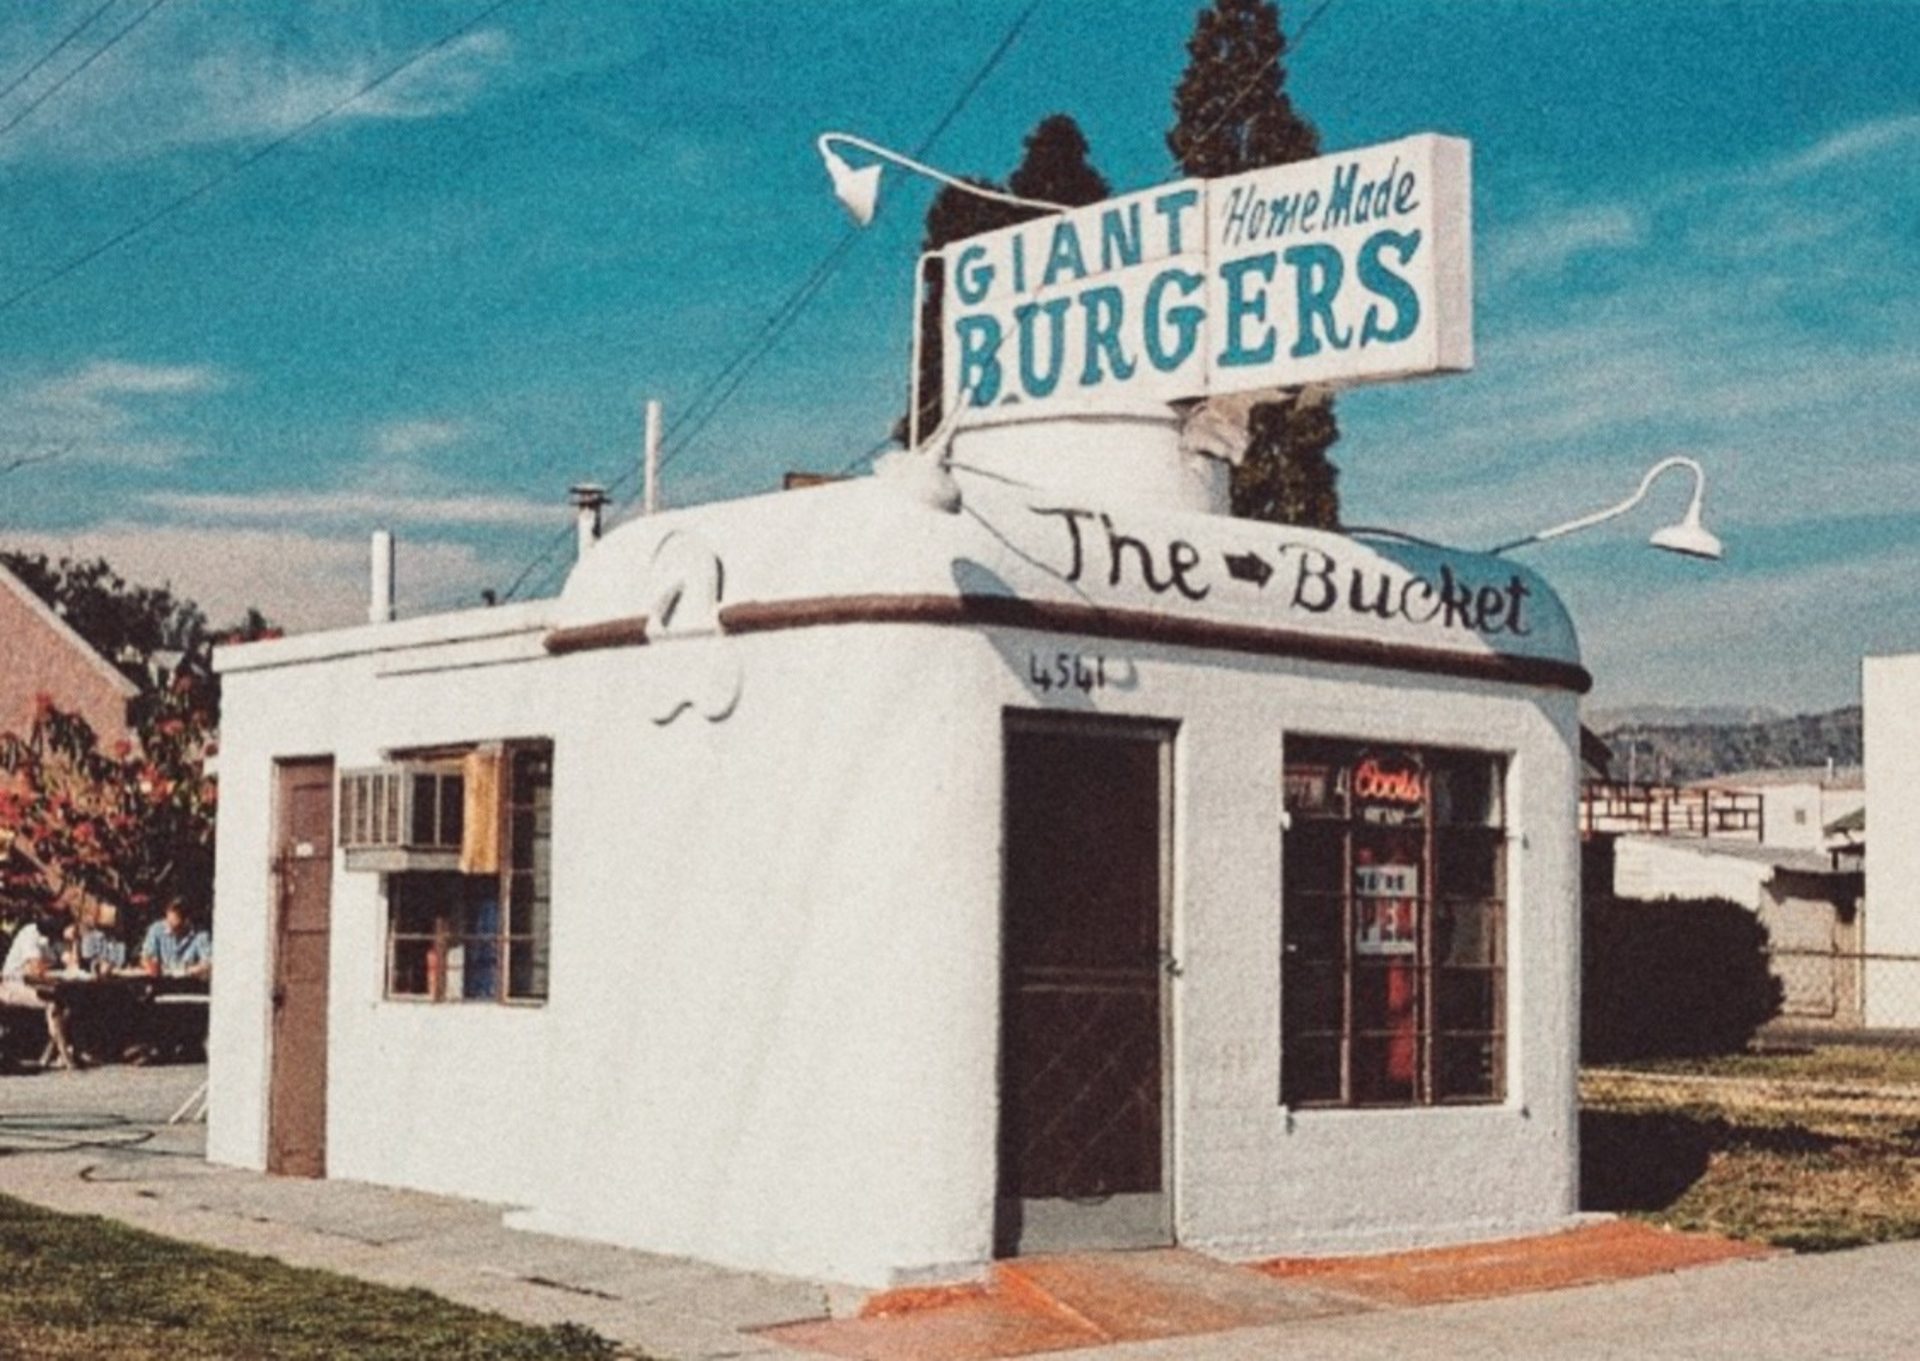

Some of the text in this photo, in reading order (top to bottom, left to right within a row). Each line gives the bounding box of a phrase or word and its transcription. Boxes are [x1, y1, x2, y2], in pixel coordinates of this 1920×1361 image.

[954, 189, 1199, 305] GIANT
[954, 229, 1423, 408] BURGERS
[1029, 506, 1532, 636] The Bucket
[1030, 652, 1106, 695] 4541
